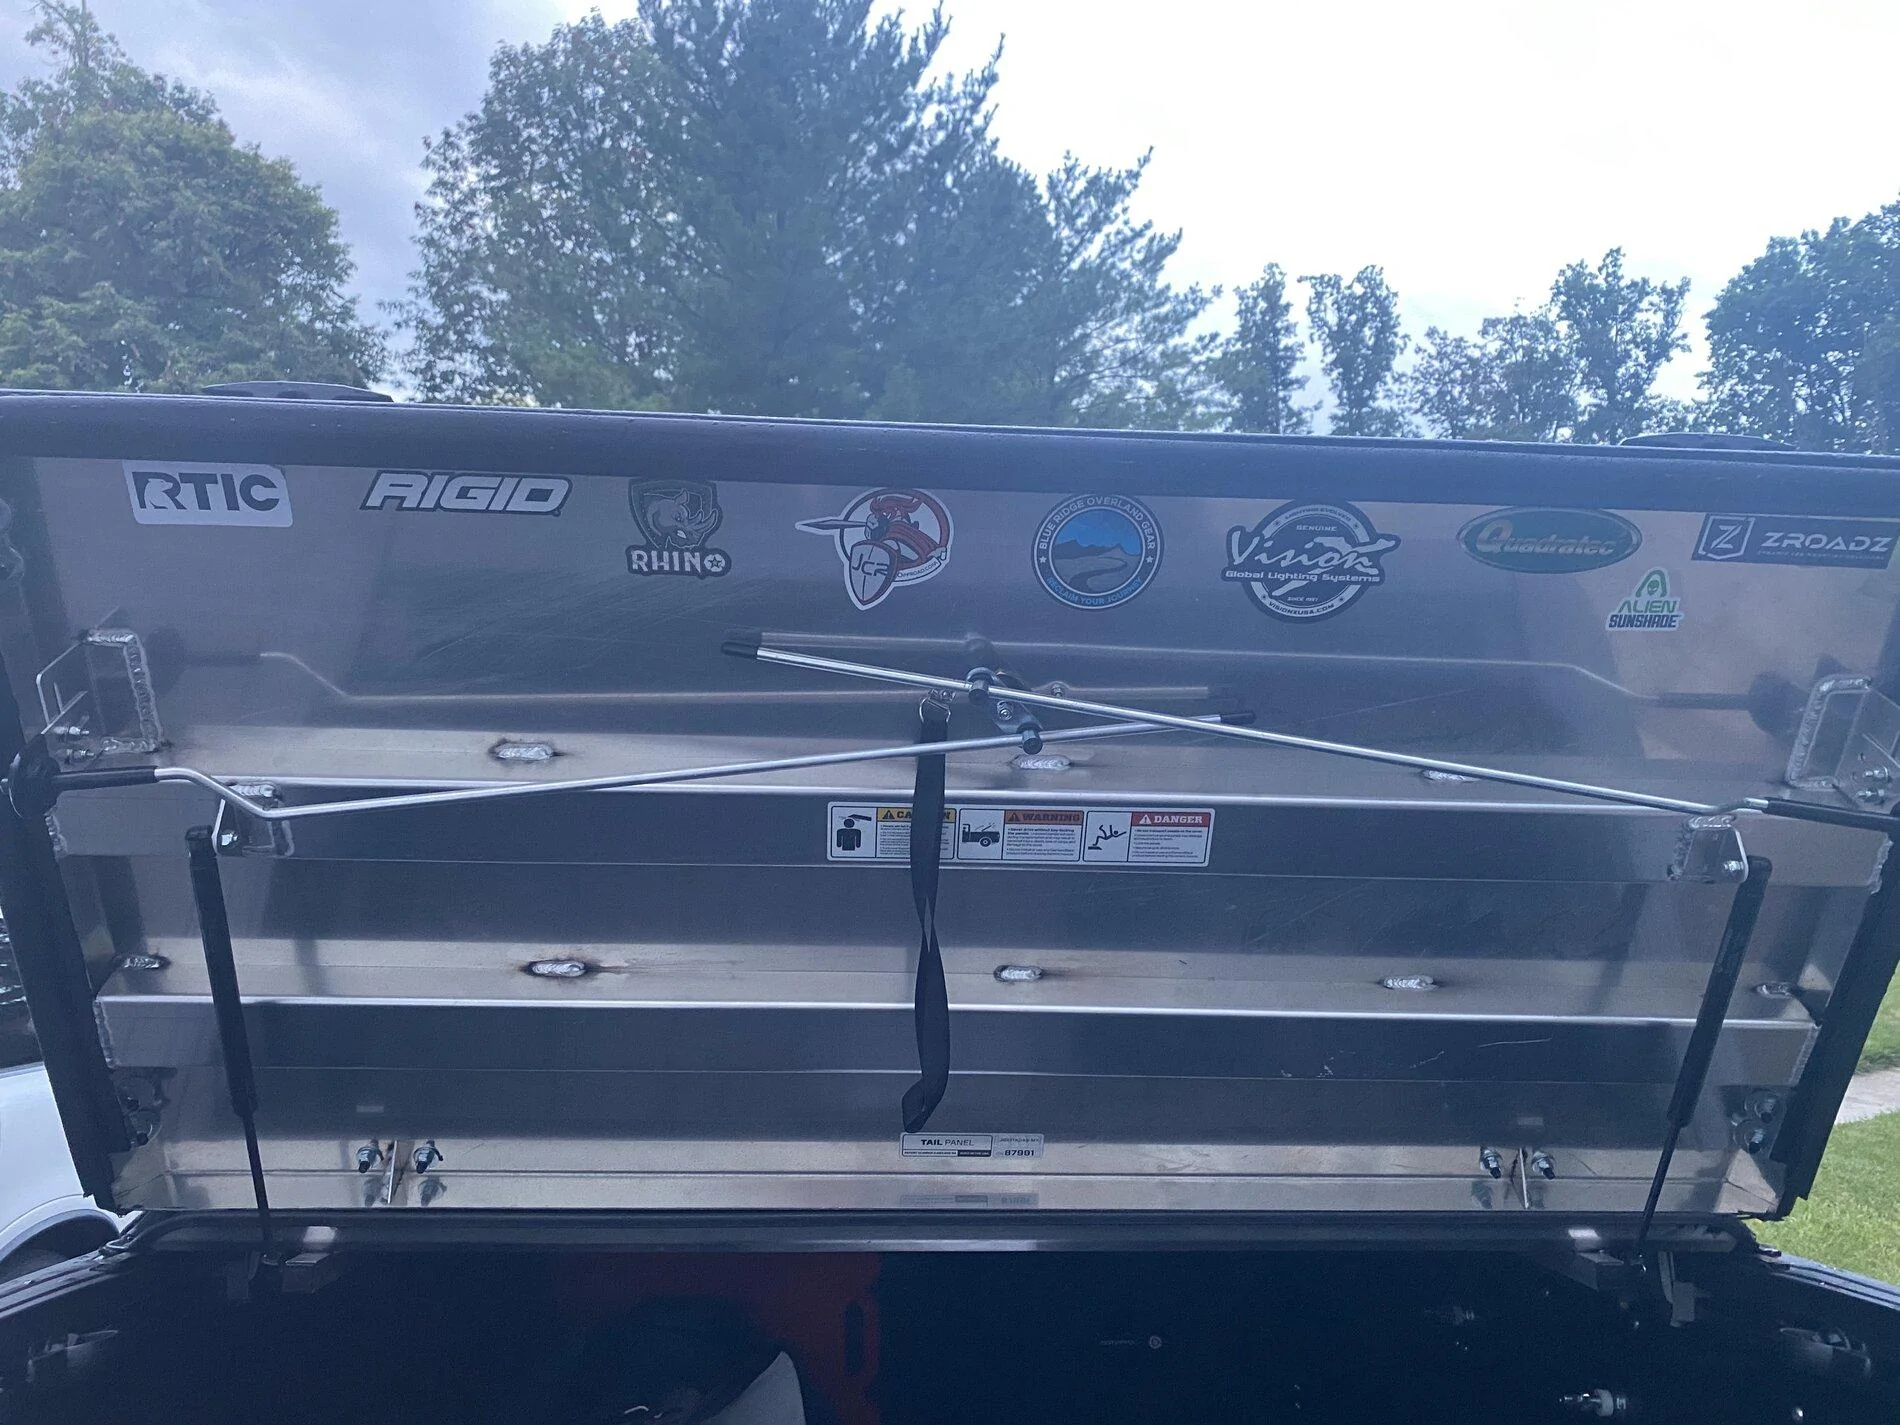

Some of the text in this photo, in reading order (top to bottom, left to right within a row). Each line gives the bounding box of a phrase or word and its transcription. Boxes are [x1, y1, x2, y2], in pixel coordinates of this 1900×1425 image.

[132, 471, 280, 511] RTIC
[364, 471, 571, 513] RIGID
[1039, 496, 1156, 550] BLUE RIDGE OVERLAND GEAR
[1296, 524, 1337, 532] GENUINE
[1476, 519, 1617, 555] Quadratec
[1760, 532, 1894, 552] ZROADZ
[631, 549, 726, 573] RHINO
[1231, 531, 1373, 568] Vision
[852, 553, 888, 577] JCR
[1226, 570, 1380, 582] Global Lighting Systems
[1047, 576, 1143, 605] RECLAIM YOUR JOURNEY
[1618, 600, 1677, 613] ALIEN
[1608, 614, 1681, 628] SUNSHADE
[1023, 813, 1079, 822] WARNING
[1154, 815, 1203, 824] DANGER
